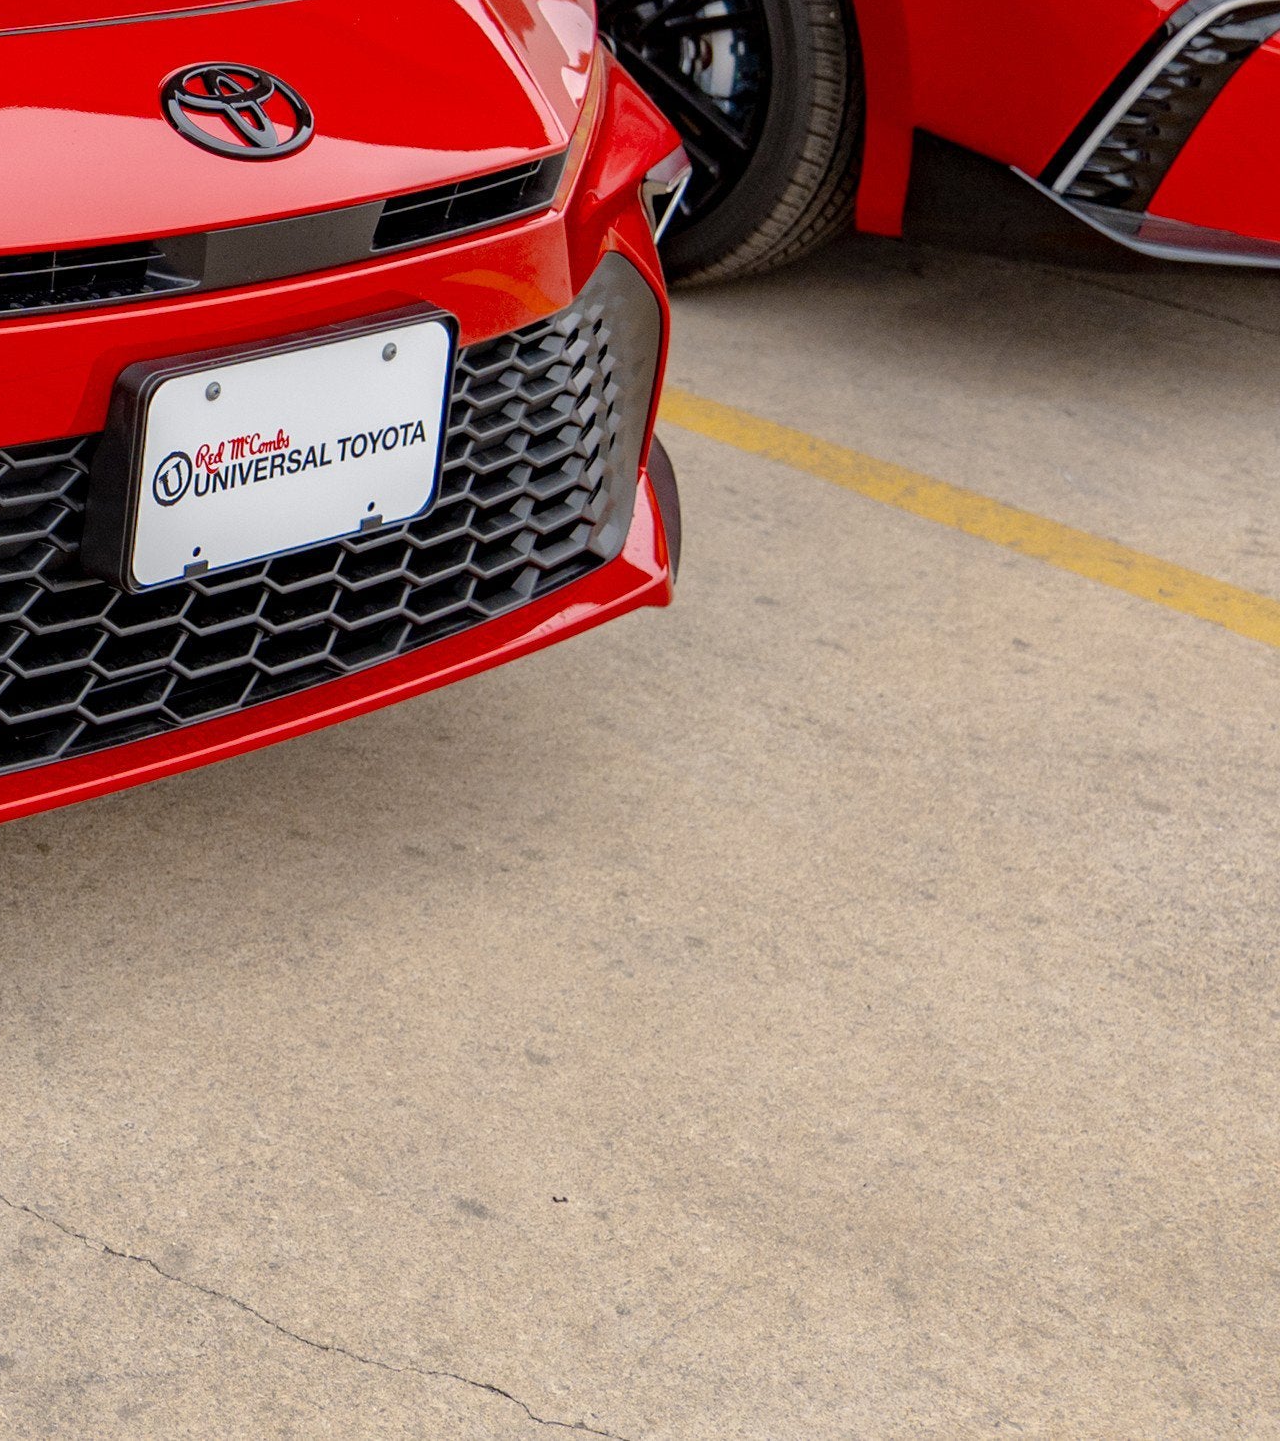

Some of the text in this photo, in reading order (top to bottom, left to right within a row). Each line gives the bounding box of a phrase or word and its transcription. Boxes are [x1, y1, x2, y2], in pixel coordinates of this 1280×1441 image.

[193, 420, 427, 497] UNIVERSAL TOYOTA
[195, 428, 290, 475] Red McCombs
